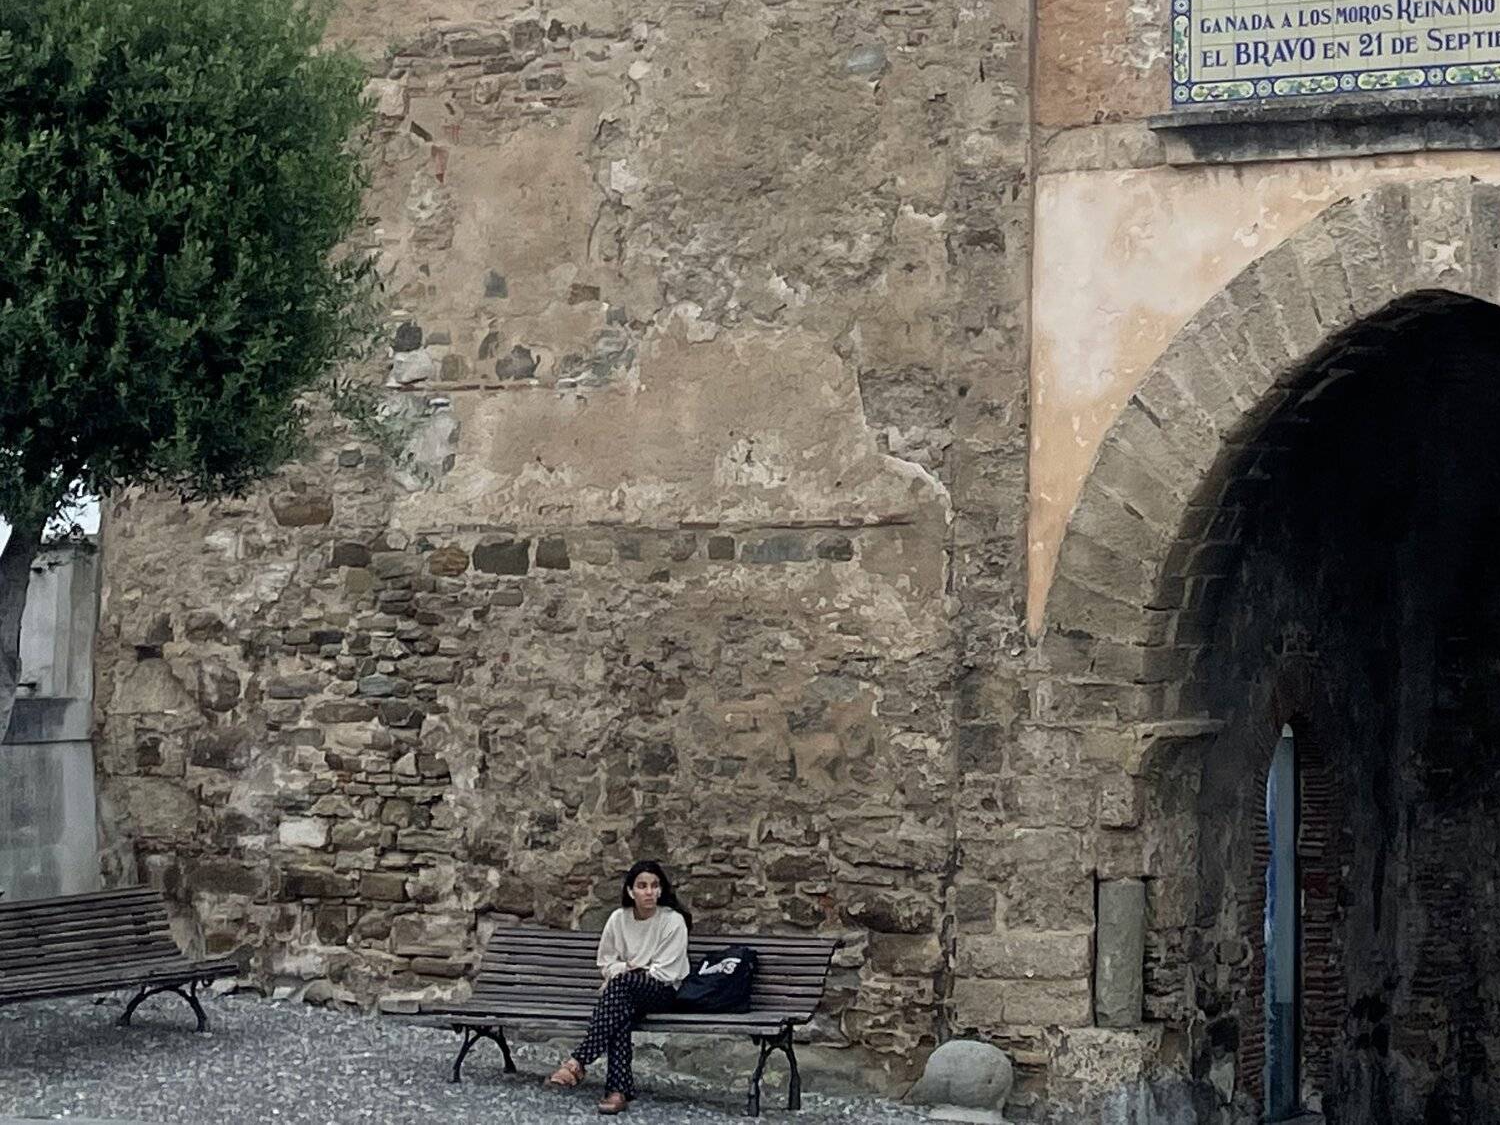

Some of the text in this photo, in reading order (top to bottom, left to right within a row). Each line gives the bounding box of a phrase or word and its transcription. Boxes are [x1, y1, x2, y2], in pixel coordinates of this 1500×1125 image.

[1200, 13, 1275, 34] GANADA
[1281, 12, 1293, 28] A
[1298, 8, 1332, 27] LOS
[1335, 3, 1394, 25] MOROS
[1201, 49, 1229, 68] EL
[1235, 37, 1316, 67] BRAVO
[1322, 41, 1351, 60] EN
[1358, 32, 1383, 57] 21
[1391, 35, 1419, 55] DE
